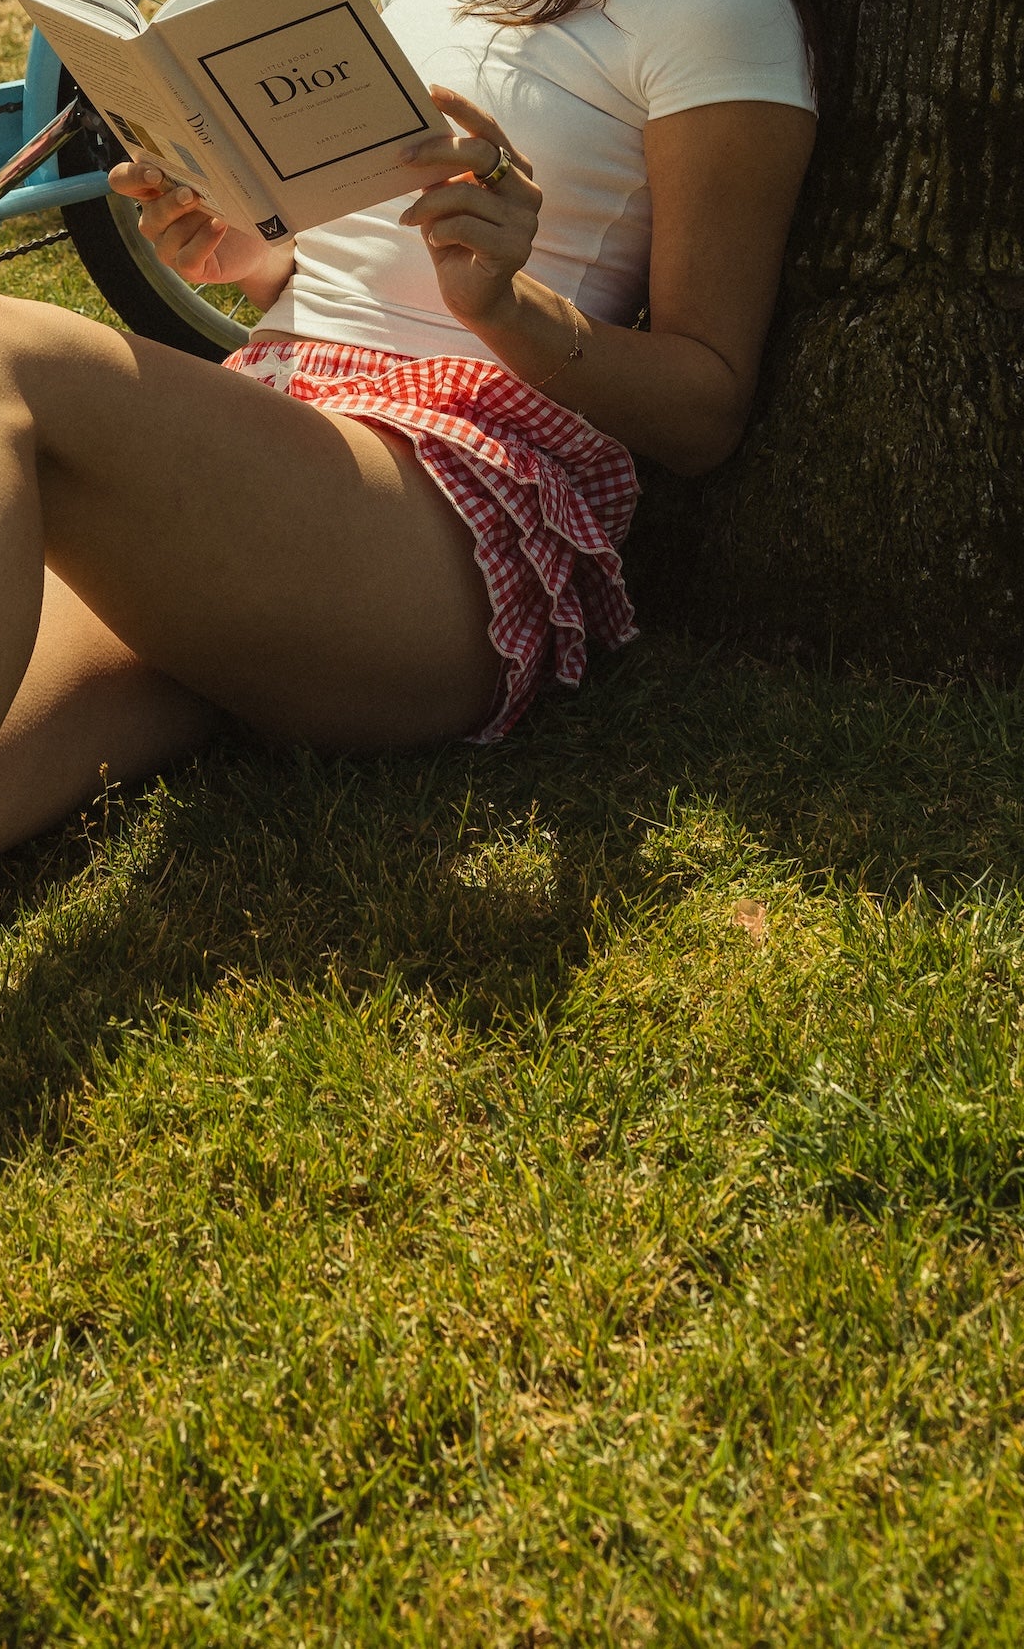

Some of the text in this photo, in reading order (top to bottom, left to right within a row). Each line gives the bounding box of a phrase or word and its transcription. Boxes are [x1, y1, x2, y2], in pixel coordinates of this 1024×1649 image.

[259, 61, 285, 75] LITTLE
[288, 52, 312, 63] BOOK
[254, 60, 351, 108] Dior
[333, 88, 354, 100] fashion
[186, 111, 214, 146] Dior
[316, 123, 367, 145] KAREN HOMER
[258, 217, 278, 235] W
